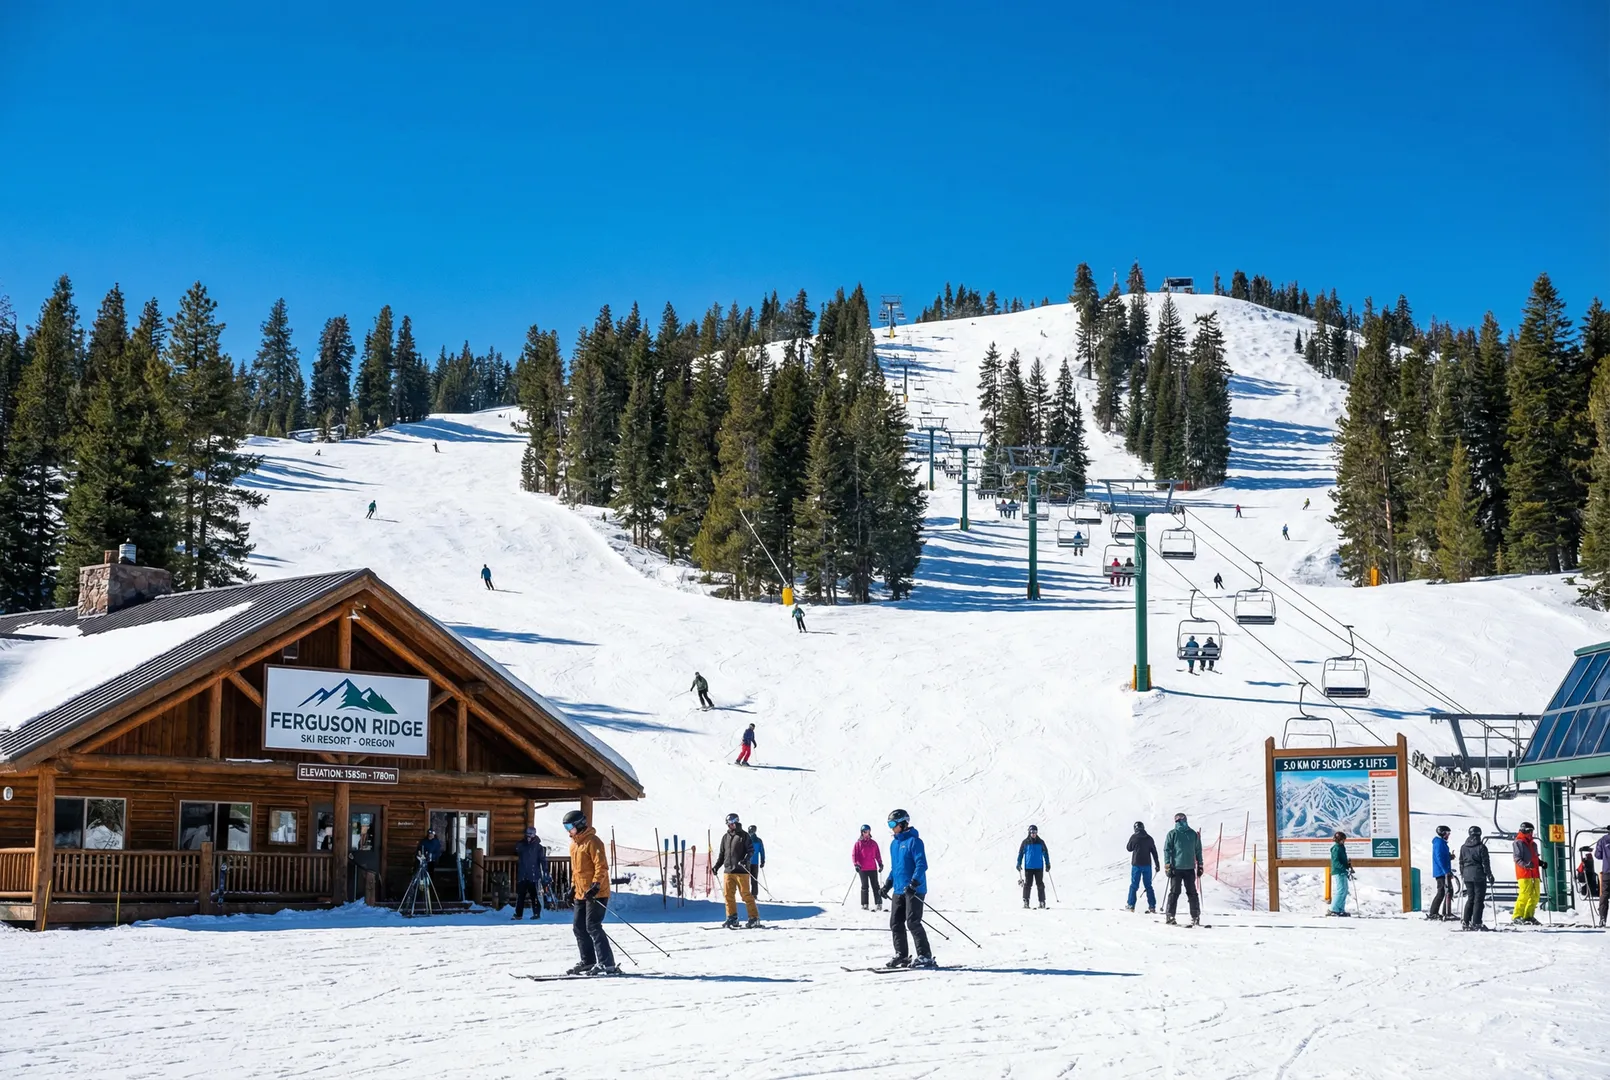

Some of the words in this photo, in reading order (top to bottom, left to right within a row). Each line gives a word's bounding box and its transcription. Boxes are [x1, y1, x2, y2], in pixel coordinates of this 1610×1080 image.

[271, 712, 366, 733] FERGUSON
[373, 719, 423, 737] RIDGE
[301, 734, 315, 743] SKI
[318, 735, 351, 745] RESORT
[359, 738, 395, 747] OREGON
[1283, 760, 1296, 770] 5.0
[1297, 760, 1309, 770] KM
[1311, 760, 1321, 769] OF
[1322, 759, 1352, 769] SLOPES
[1359, 759, 1364, 768] 5
[1365, 758, 1388, 768] LIFTS
[301, 768, 344, 778] ELEVATION:
[345, 770, 367, 779] 1585m
[373, 771, 395, 780] 1780m
